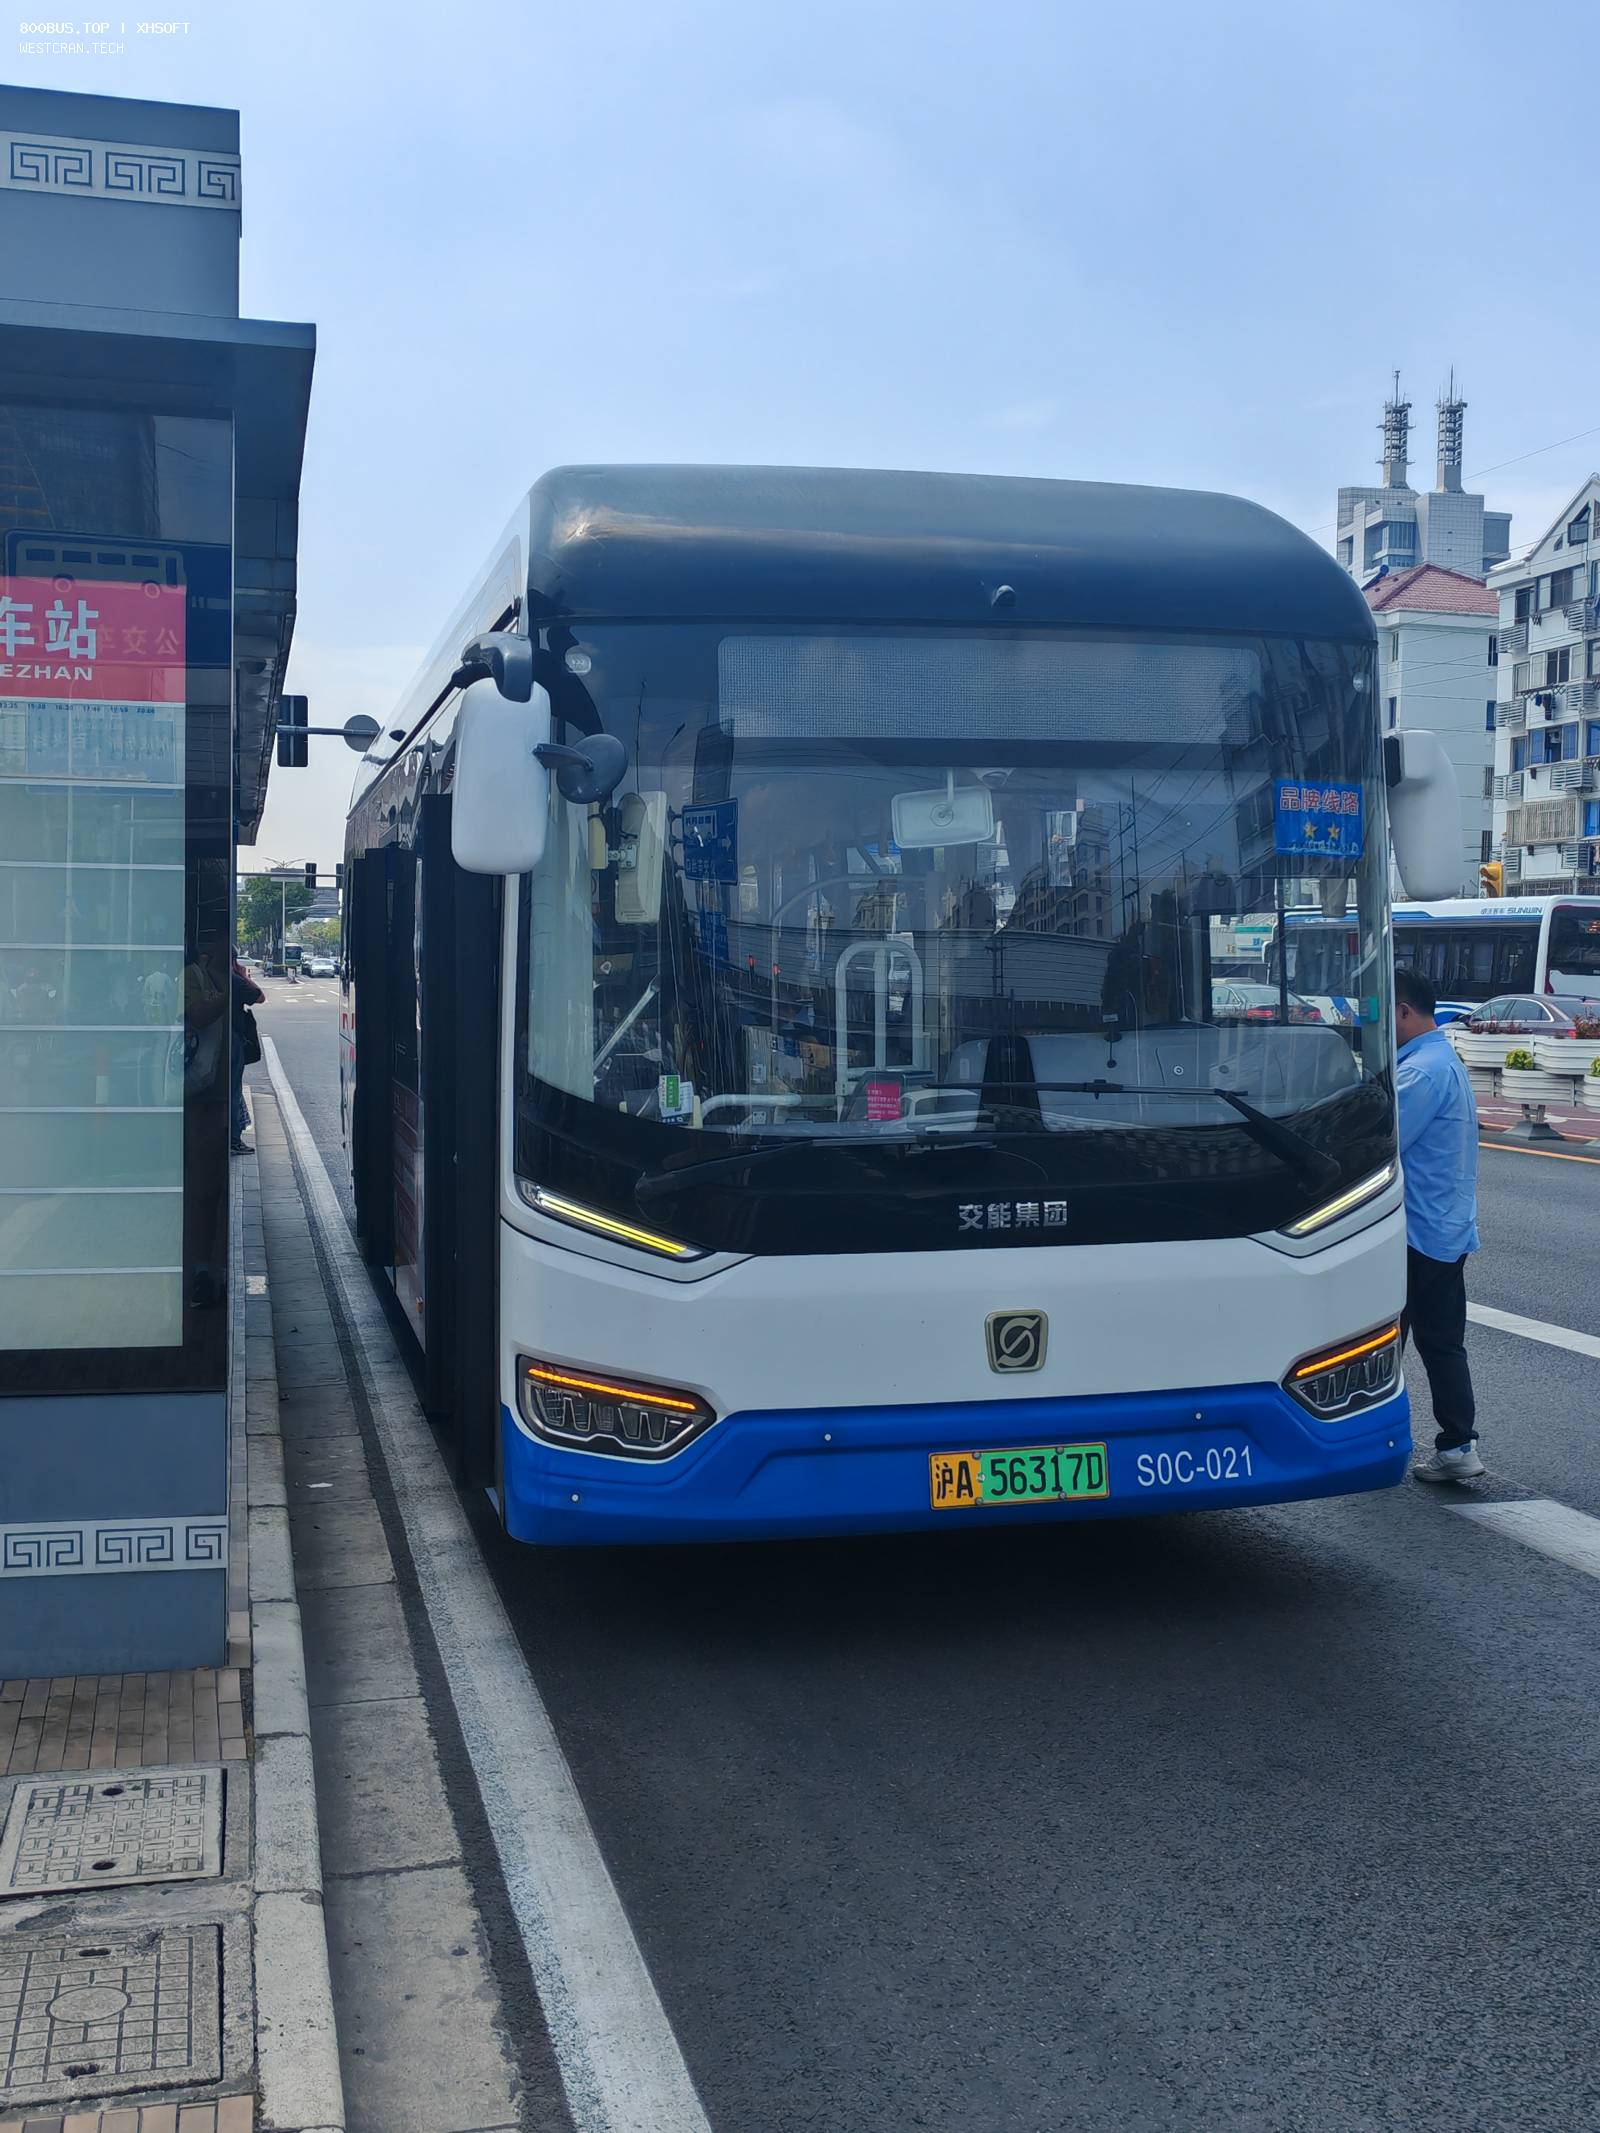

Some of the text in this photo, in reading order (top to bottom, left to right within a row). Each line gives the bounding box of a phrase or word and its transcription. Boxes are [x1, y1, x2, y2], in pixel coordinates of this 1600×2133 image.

[0, 596, 99, 660] 车站
[1280, 787, 1359, 815] 品牌线路
[959, 1201, 1068, 1230] 交能集团
[990, 1451, 1105, 1496] 56317D
